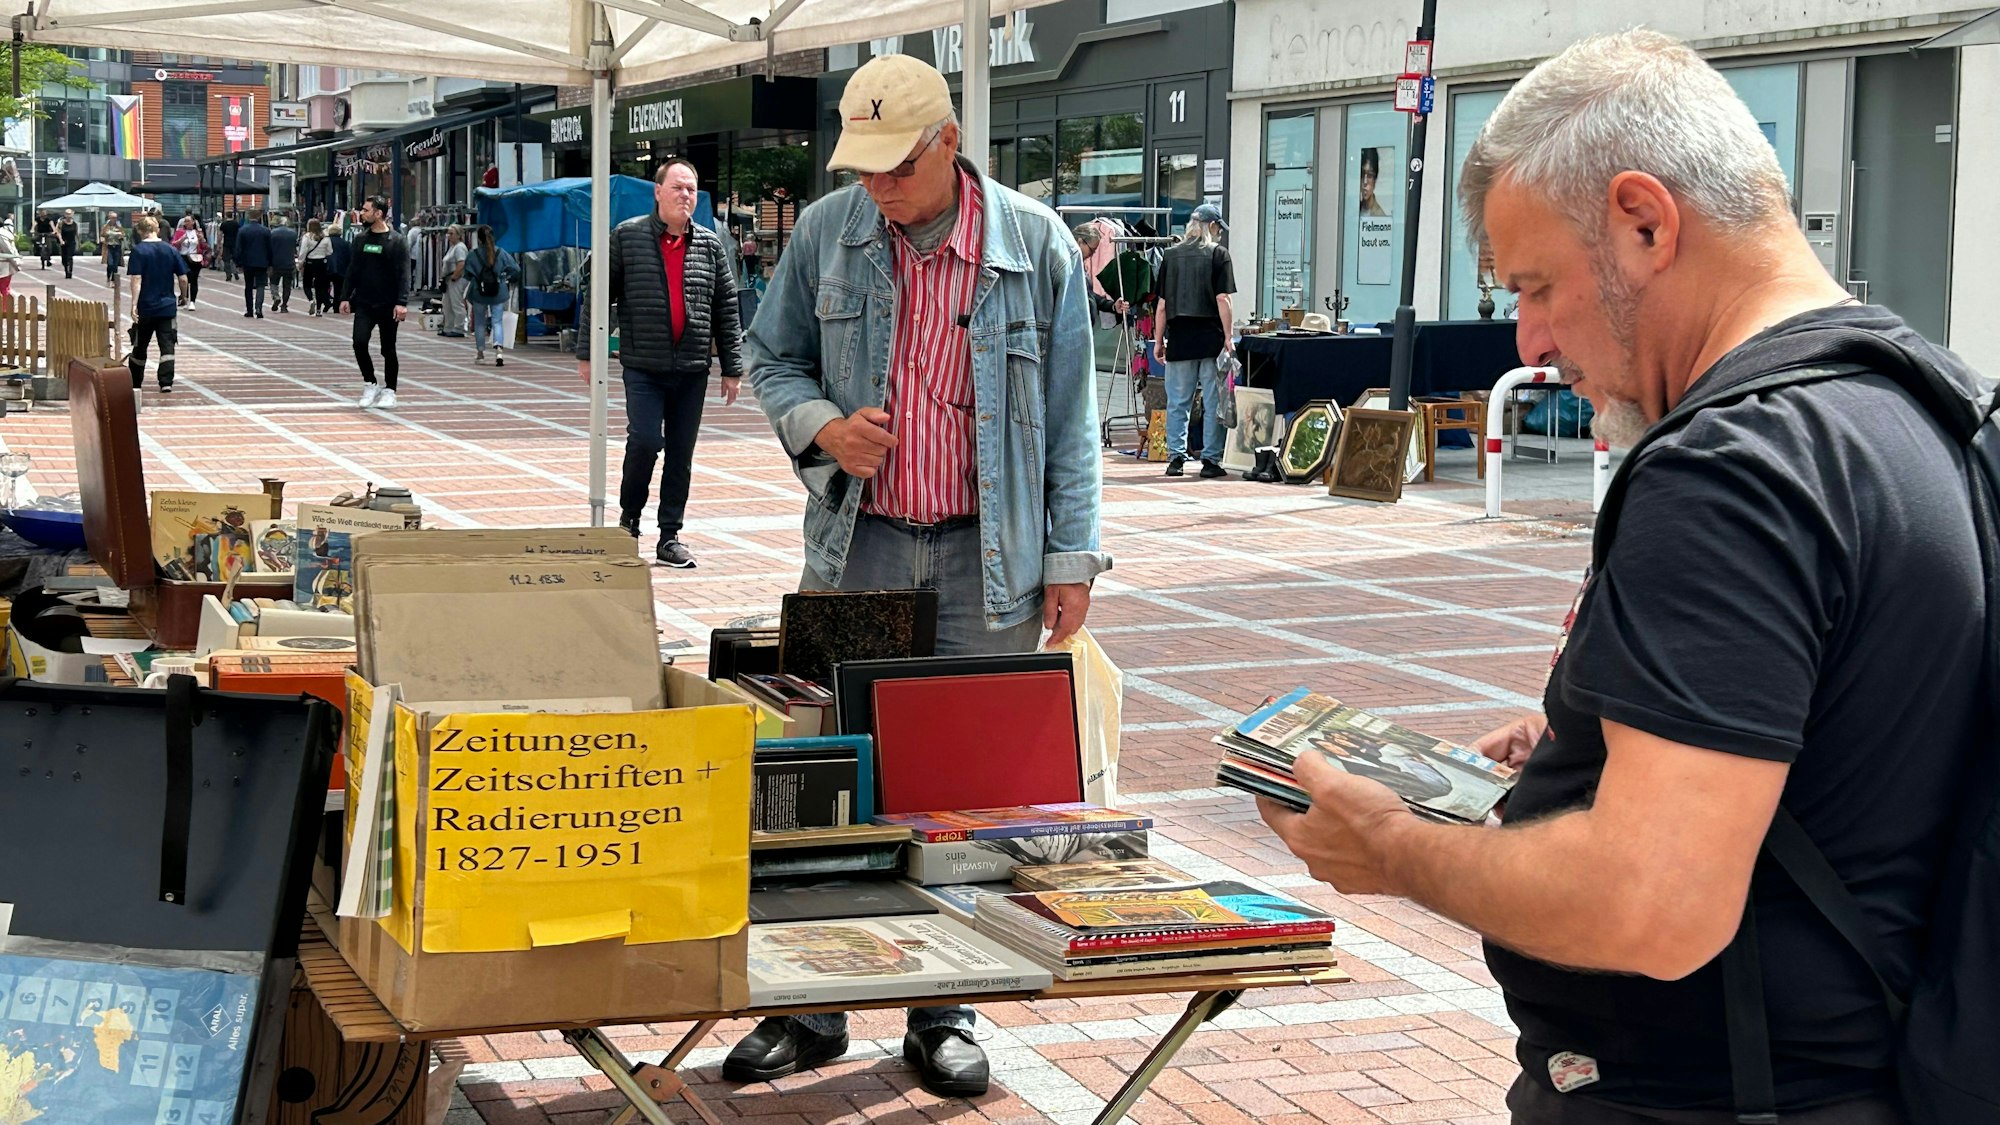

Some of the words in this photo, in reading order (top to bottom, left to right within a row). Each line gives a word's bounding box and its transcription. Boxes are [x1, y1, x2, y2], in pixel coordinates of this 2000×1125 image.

[273, 107, 306, 118] TLS
[628, 98, 683, 134] LEVERKUSEN
[1168, 90, 1186, 123] 11
[405, 127, 443, 156] Trendy
[1361, 221, 1392, 232] Fielmann
[1361, 237, 1378, 247] baut
[312, 516, 325, 524] Wie
[337, 518, 353, 526] Welt
[433, 729, 648, 757] Zeitungen,
[432, 764, 684, 793] Zeitschriften
[697, 761, 720, 779] +
[431, 805, 683, 832] Radierungen
[934, 830, 963, 842] TOPP
[436, 841, 644, 872] 1827-1951
[945, 851, 967, 862] eins
[952, 860, 998, 875] Auswahl
[20, 991, 37, 1005] 6
[52, 994, 69, 1007] 7
[233, 993, 249, 1022] super.
[152, 998, 172, 1022] 10
[210, 1007, 224, 1033] ARAL
[227, 1027, 241, 1050] Alles
[139, 1054, 160, 1073] 11
[176, 1055, 194, 1076] 12
